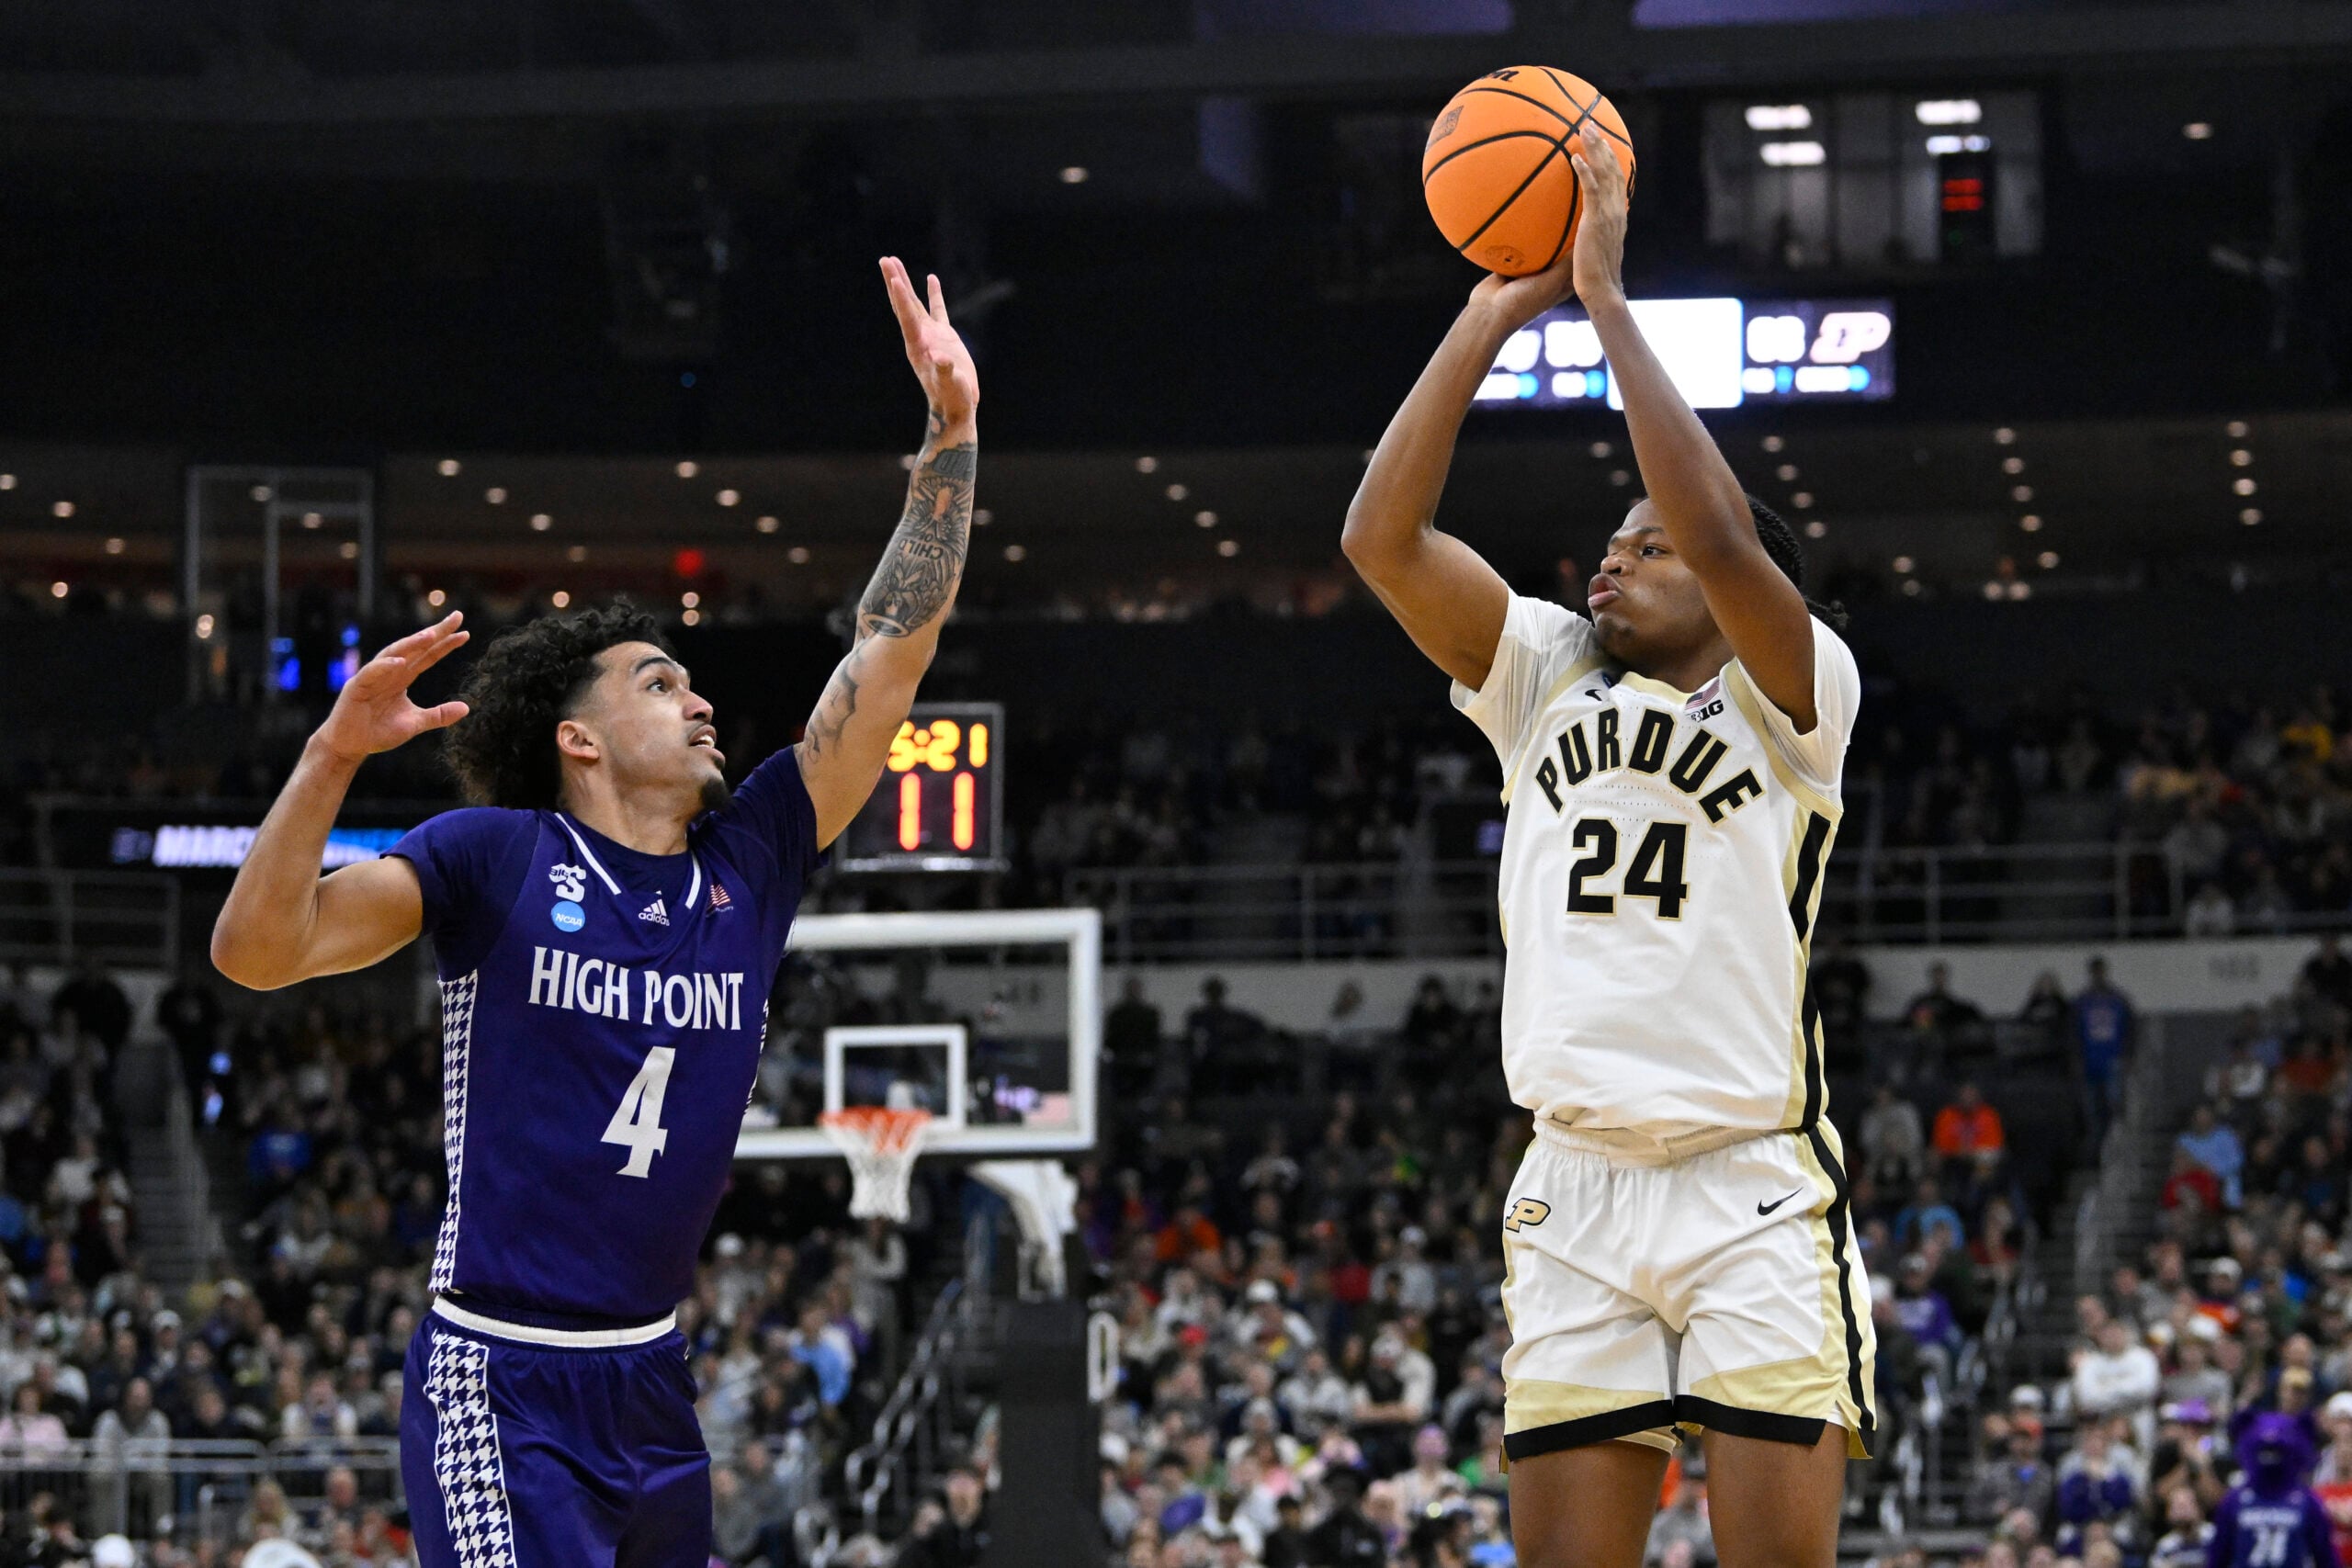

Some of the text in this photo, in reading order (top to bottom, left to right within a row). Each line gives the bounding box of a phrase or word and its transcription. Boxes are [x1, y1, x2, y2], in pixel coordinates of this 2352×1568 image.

[898, 540, 944, 560] CHILD
[1535, 705, 1767, 826] PURDUE
[899, 772, 975, 851] 11
[1566, 817, 1690, 921] 24
[555, 912, 583, 927] NCAA
[638, 912, 670, 926] adidas
[527, 945, 744, 1031] HIGH POINT
[600, 1045, 676, 1179] 4
[1505, 1197, 1551, 1234] P
